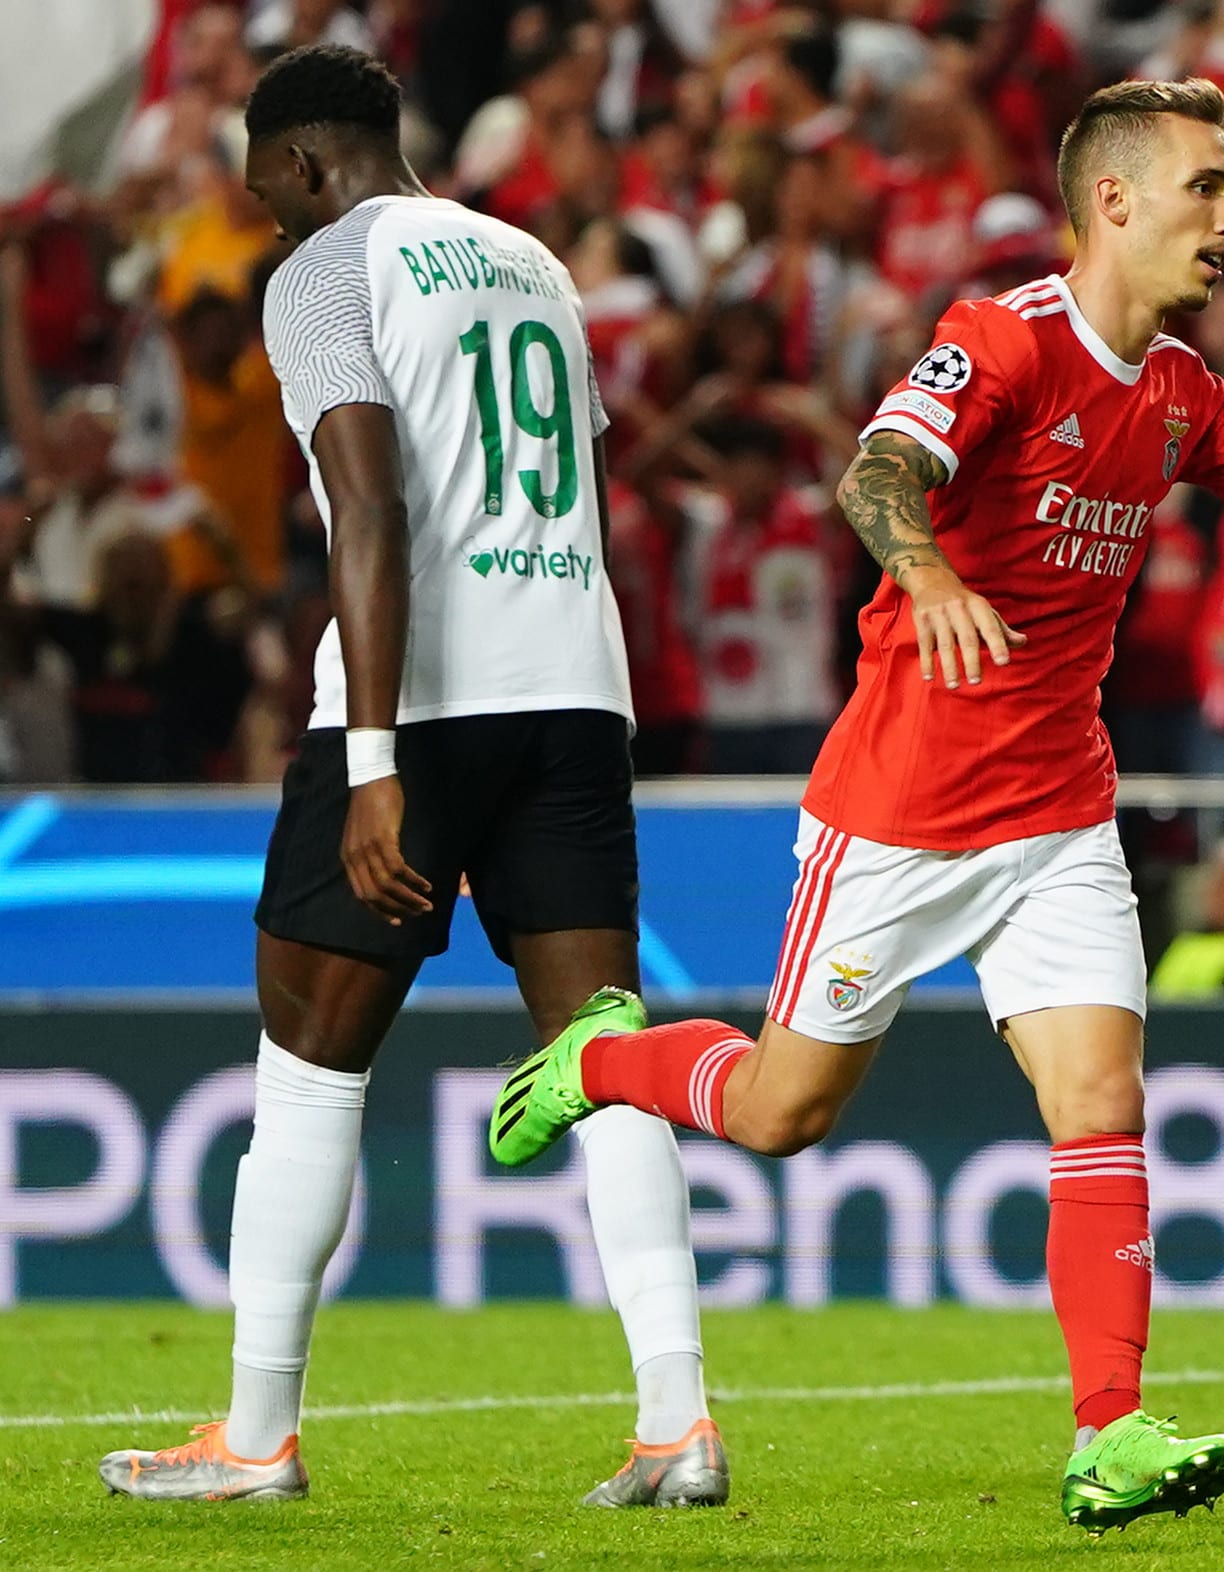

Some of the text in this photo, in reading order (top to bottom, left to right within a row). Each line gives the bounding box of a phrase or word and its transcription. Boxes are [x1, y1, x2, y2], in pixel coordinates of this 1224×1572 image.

[459, 320, 578, 519] 19
[1049, 430, 1085, 449] adidas
[494, 544, 592, 591] variety
[1042, 533, 1083, 569] FLY
